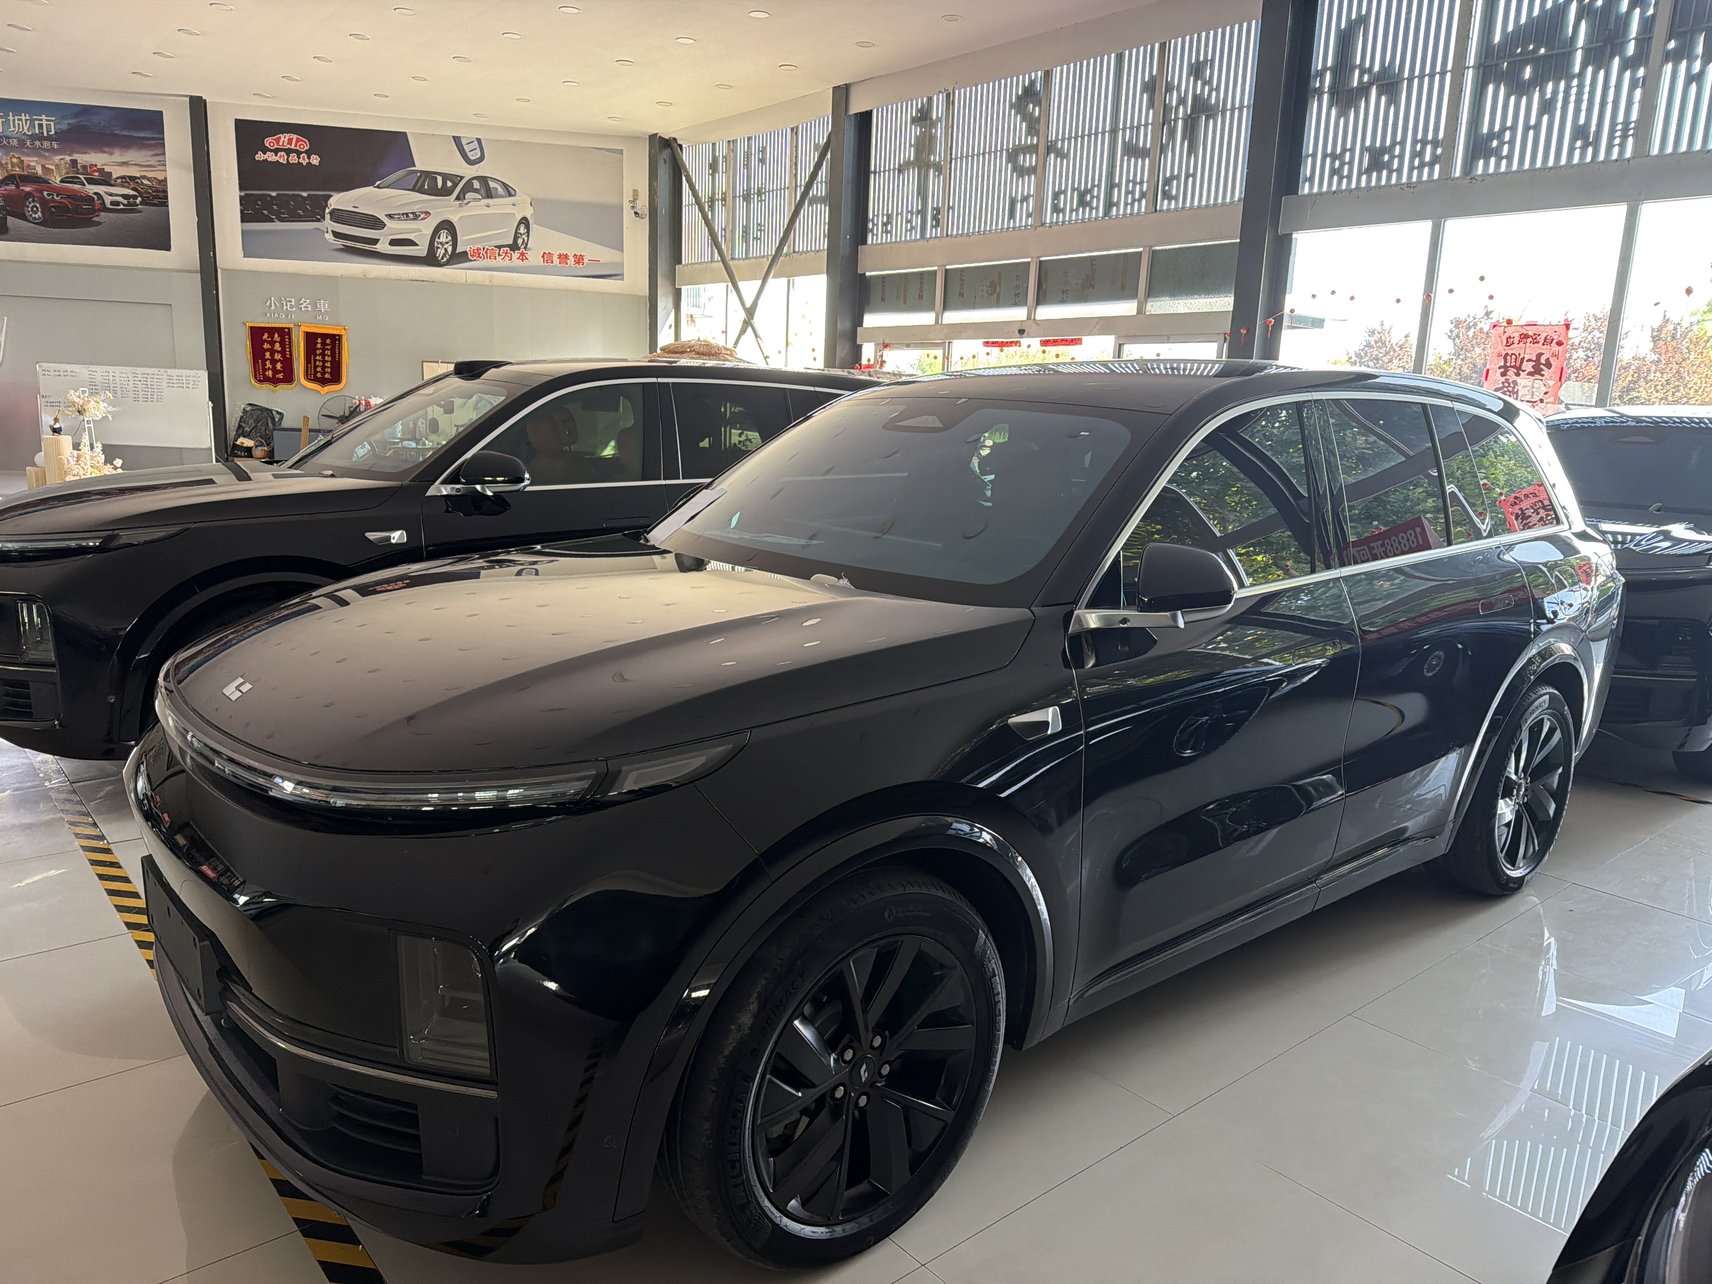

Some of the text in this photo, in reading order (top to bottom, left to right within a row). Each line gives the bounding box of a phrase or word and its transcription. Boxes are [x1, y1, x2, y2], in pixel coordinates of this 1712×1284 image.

[24, 139, 61, 150] 无水泡车
[467, 246, 602, 267] 诚信为本 信誉第一
[266, 297, 330, 313] 小记名車
